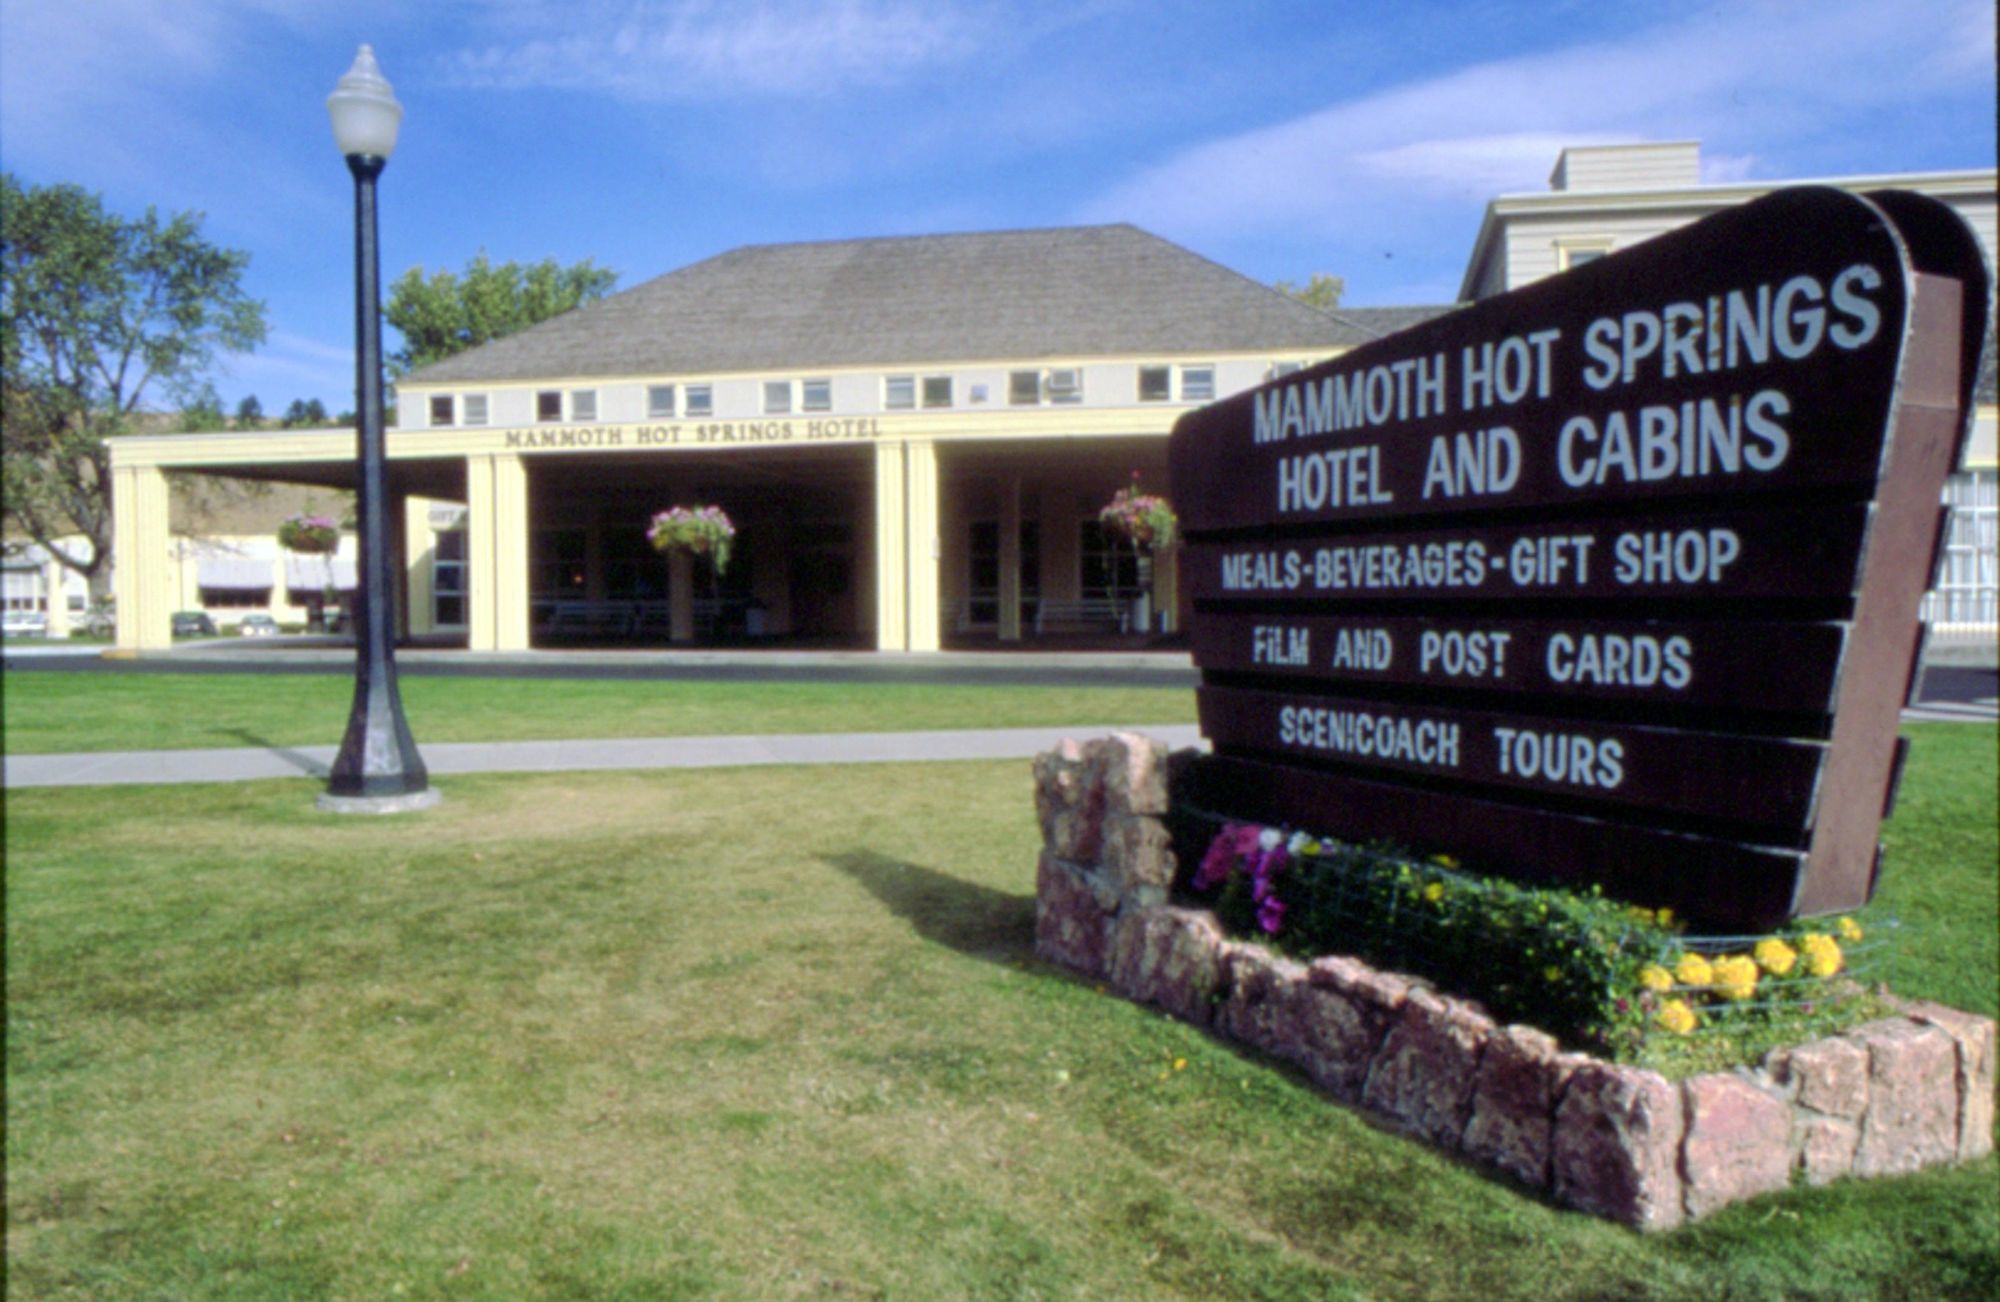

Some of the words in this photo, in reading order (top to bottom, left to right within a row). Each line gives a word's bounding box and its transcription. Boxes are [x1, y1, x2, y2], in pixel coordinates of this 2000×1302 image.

[1253, 354, 1446, 444] MAMMOTH
[1463, 329, 1561, 409] HOT
[1583, 264, 1883, 391] SPRINGS
[505, 427, 622, 447] MAMMOTH
[637, 424, 681, 444] HOT
[696, 422, 793, 442] SPRINGS
[808, 417, 882, 439] HOTEL
[1279, 445, 1393, 511] HOTEL
[1422, 427, 1522, 498] AND
[1557, 389, 1791, 487] CABINS
[1614, 530, 1740, 584] SHOP
[1253, 626, 1309, 666] FILM
[1333, 629, 1393, 670] AND
[1420, 631, 1511, 678] POST
[1547, 633, 1693, 689] CARDS
[1279, 706, 1460, 767] SCENICOACH
[1493, 727, 1624, 789] TOURS
